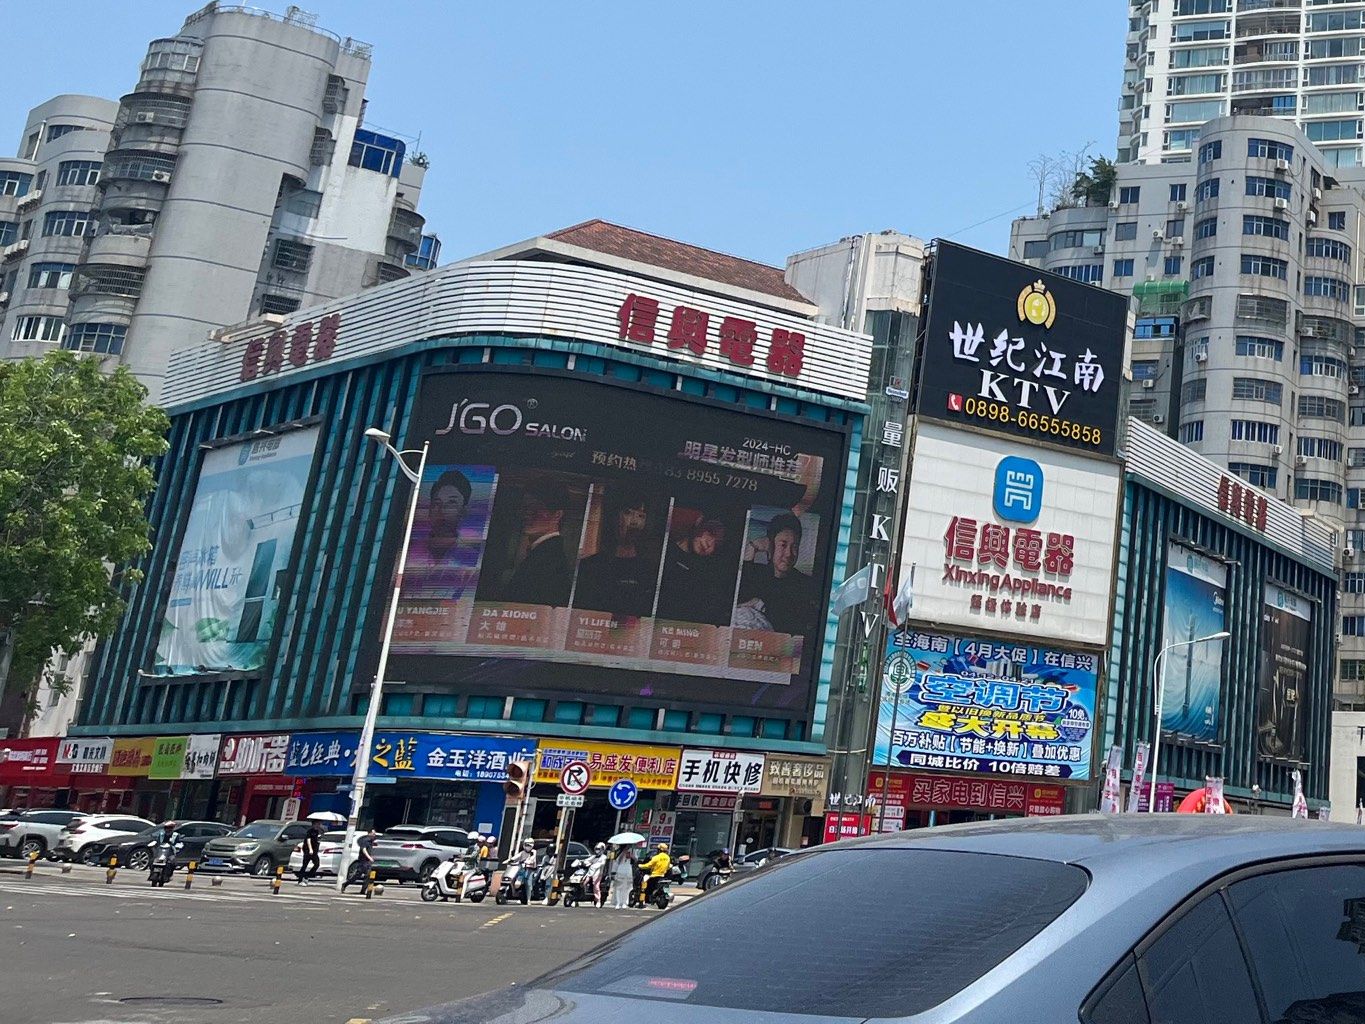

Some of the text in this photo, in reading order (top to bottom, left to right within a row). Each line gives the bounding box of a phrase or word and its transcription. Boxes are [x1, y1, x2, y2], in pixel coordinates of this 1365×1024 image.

[617, 292, 807, 378] 信興電器
[949, 320, 1105, 393] 世纪江南
[977, 368, 1071, 415] KTV
[524, 422, 588, 442] SALON
[965, 397, 1101, 445] 0898-66555858
[944, 516, 1075, 577] 信興電器
[942, 563, 1073, 602] Xinxing Appliance
[738, 638, 764, 651] BEN
[920, 674, 1067, 712] 空调节
[917, 711, 1062, 740] 盛大开幕
[590, 752, 678, 776] 易盛发便利店
[682, 759, 763, 787] 手机快修
[910, 753, 1061, 777] 同城比价 10倍赔差
[912, 778, 1025, 809] 买家电到信兴
